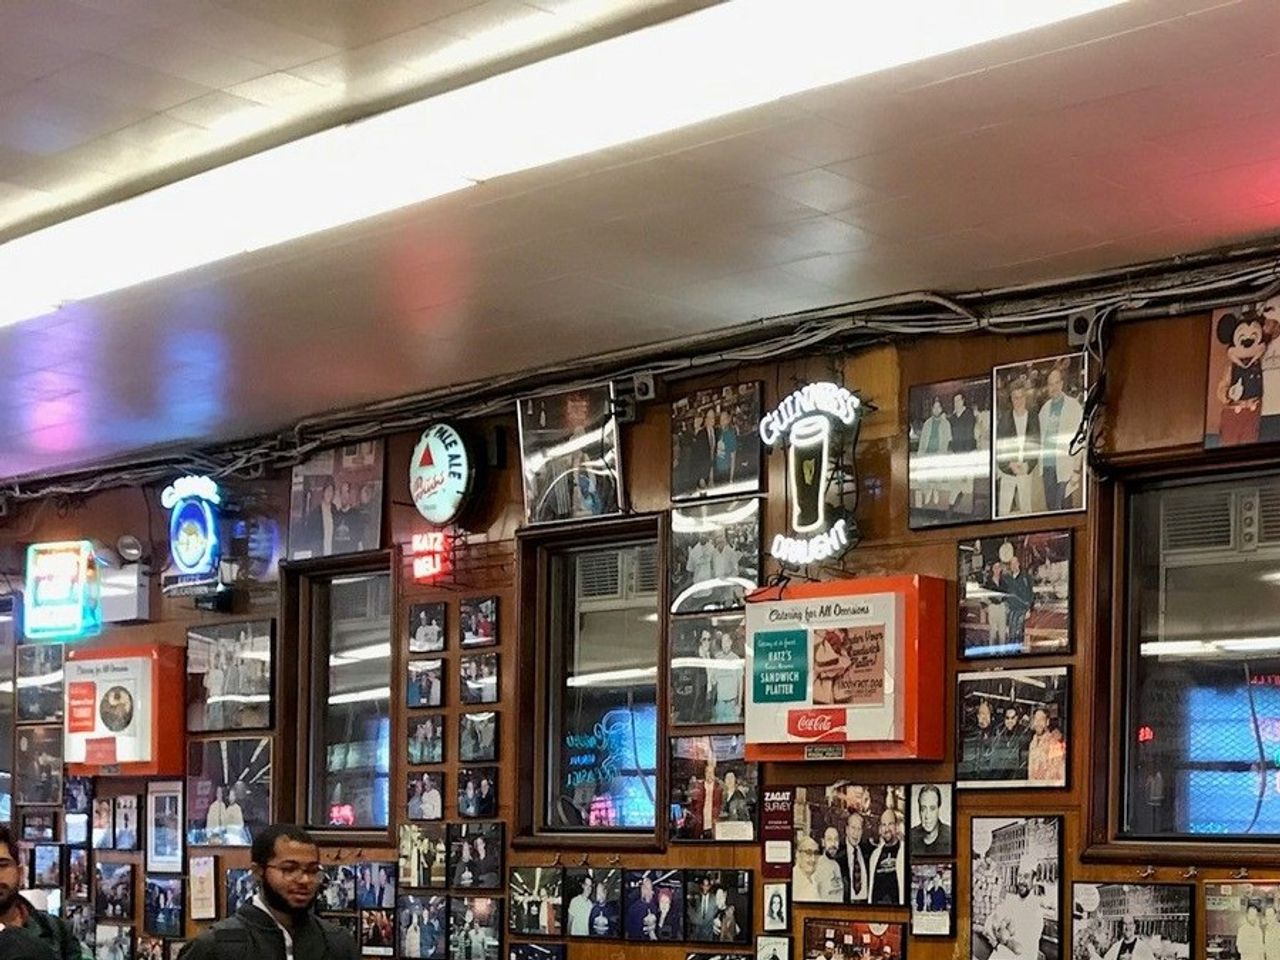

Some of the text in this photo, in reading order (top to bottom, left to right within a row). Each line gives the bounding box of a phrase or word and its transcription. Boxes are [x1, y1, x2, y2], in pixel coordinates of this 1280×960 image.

[759, 381, 861, 446] GUINNESS
[434, 426, 463, 481] PALE ALE
[819, 604, 832, 617] All
[760, 671, 800, 684] SANDWICH
[764, 683, 794, 696] PLATTER
[764, 791, 791, 802] ZAGAT
[764, 801, 792, 812] SURVEY
